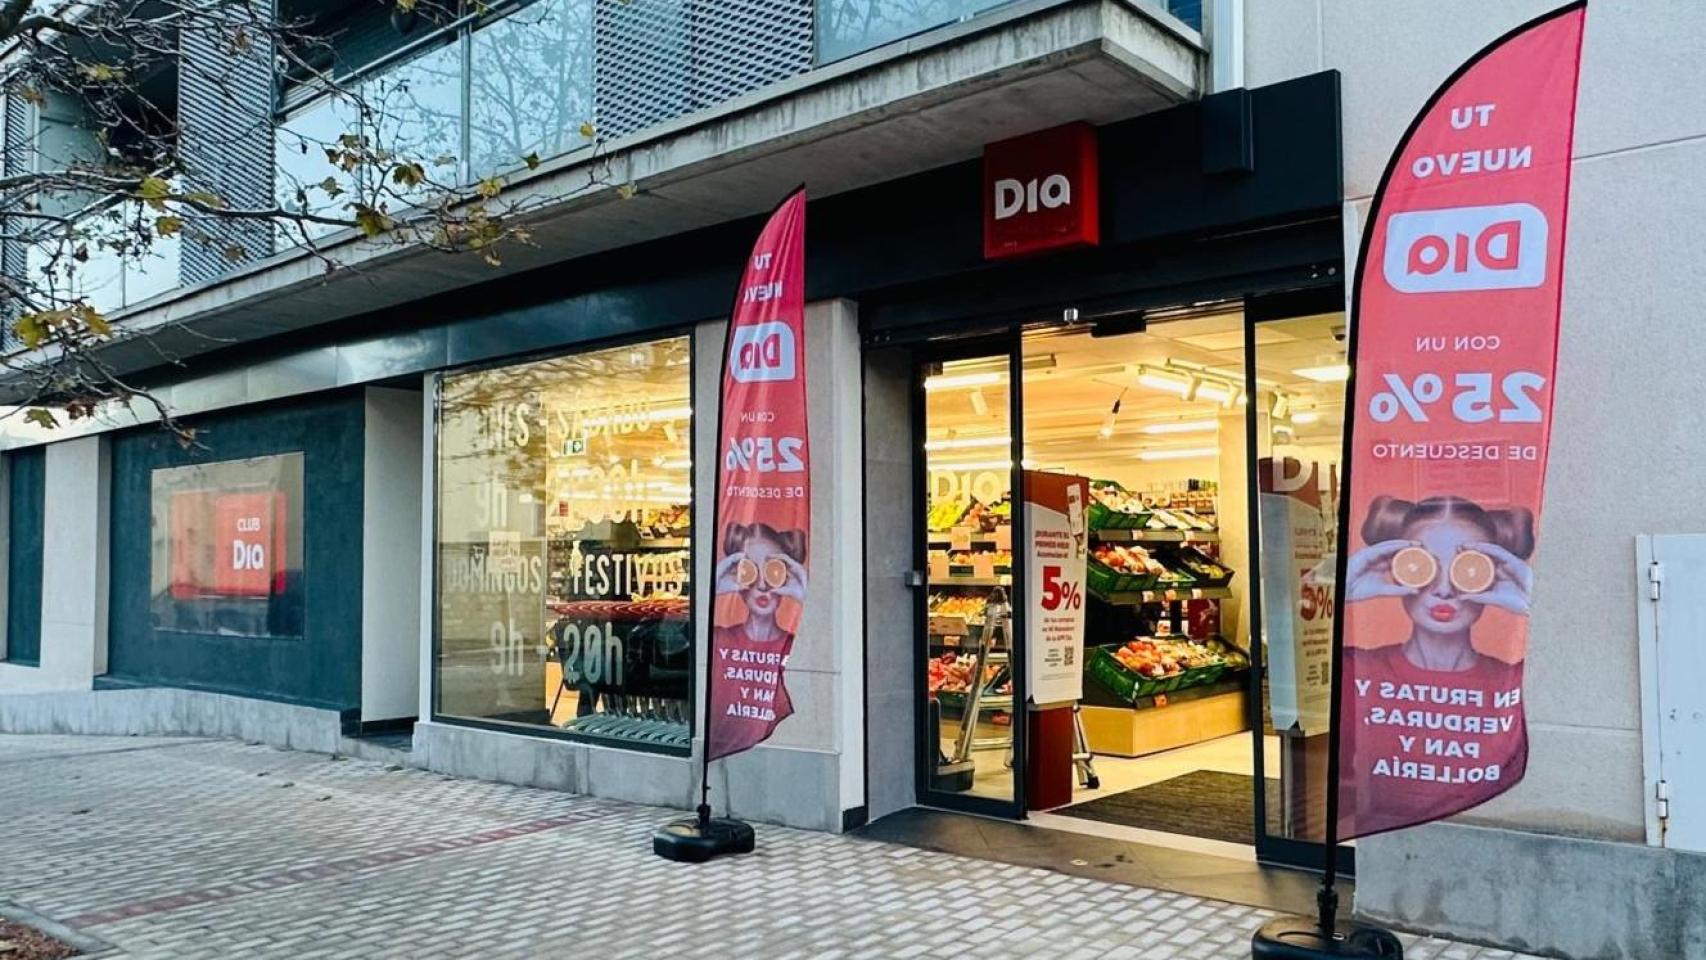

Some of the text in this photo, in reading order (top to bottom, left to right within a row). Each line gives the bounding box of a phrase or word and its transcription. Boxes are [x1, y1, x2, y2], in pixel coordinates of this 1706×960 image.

[237, 517, 261, 532] CLUB
[571, 553, 684, 597] FESTIVOS
[1041, 566, 1081, 611] 5%
[490, 616, 524, 677] 9h
[563, 619, 624, 687] 20h
